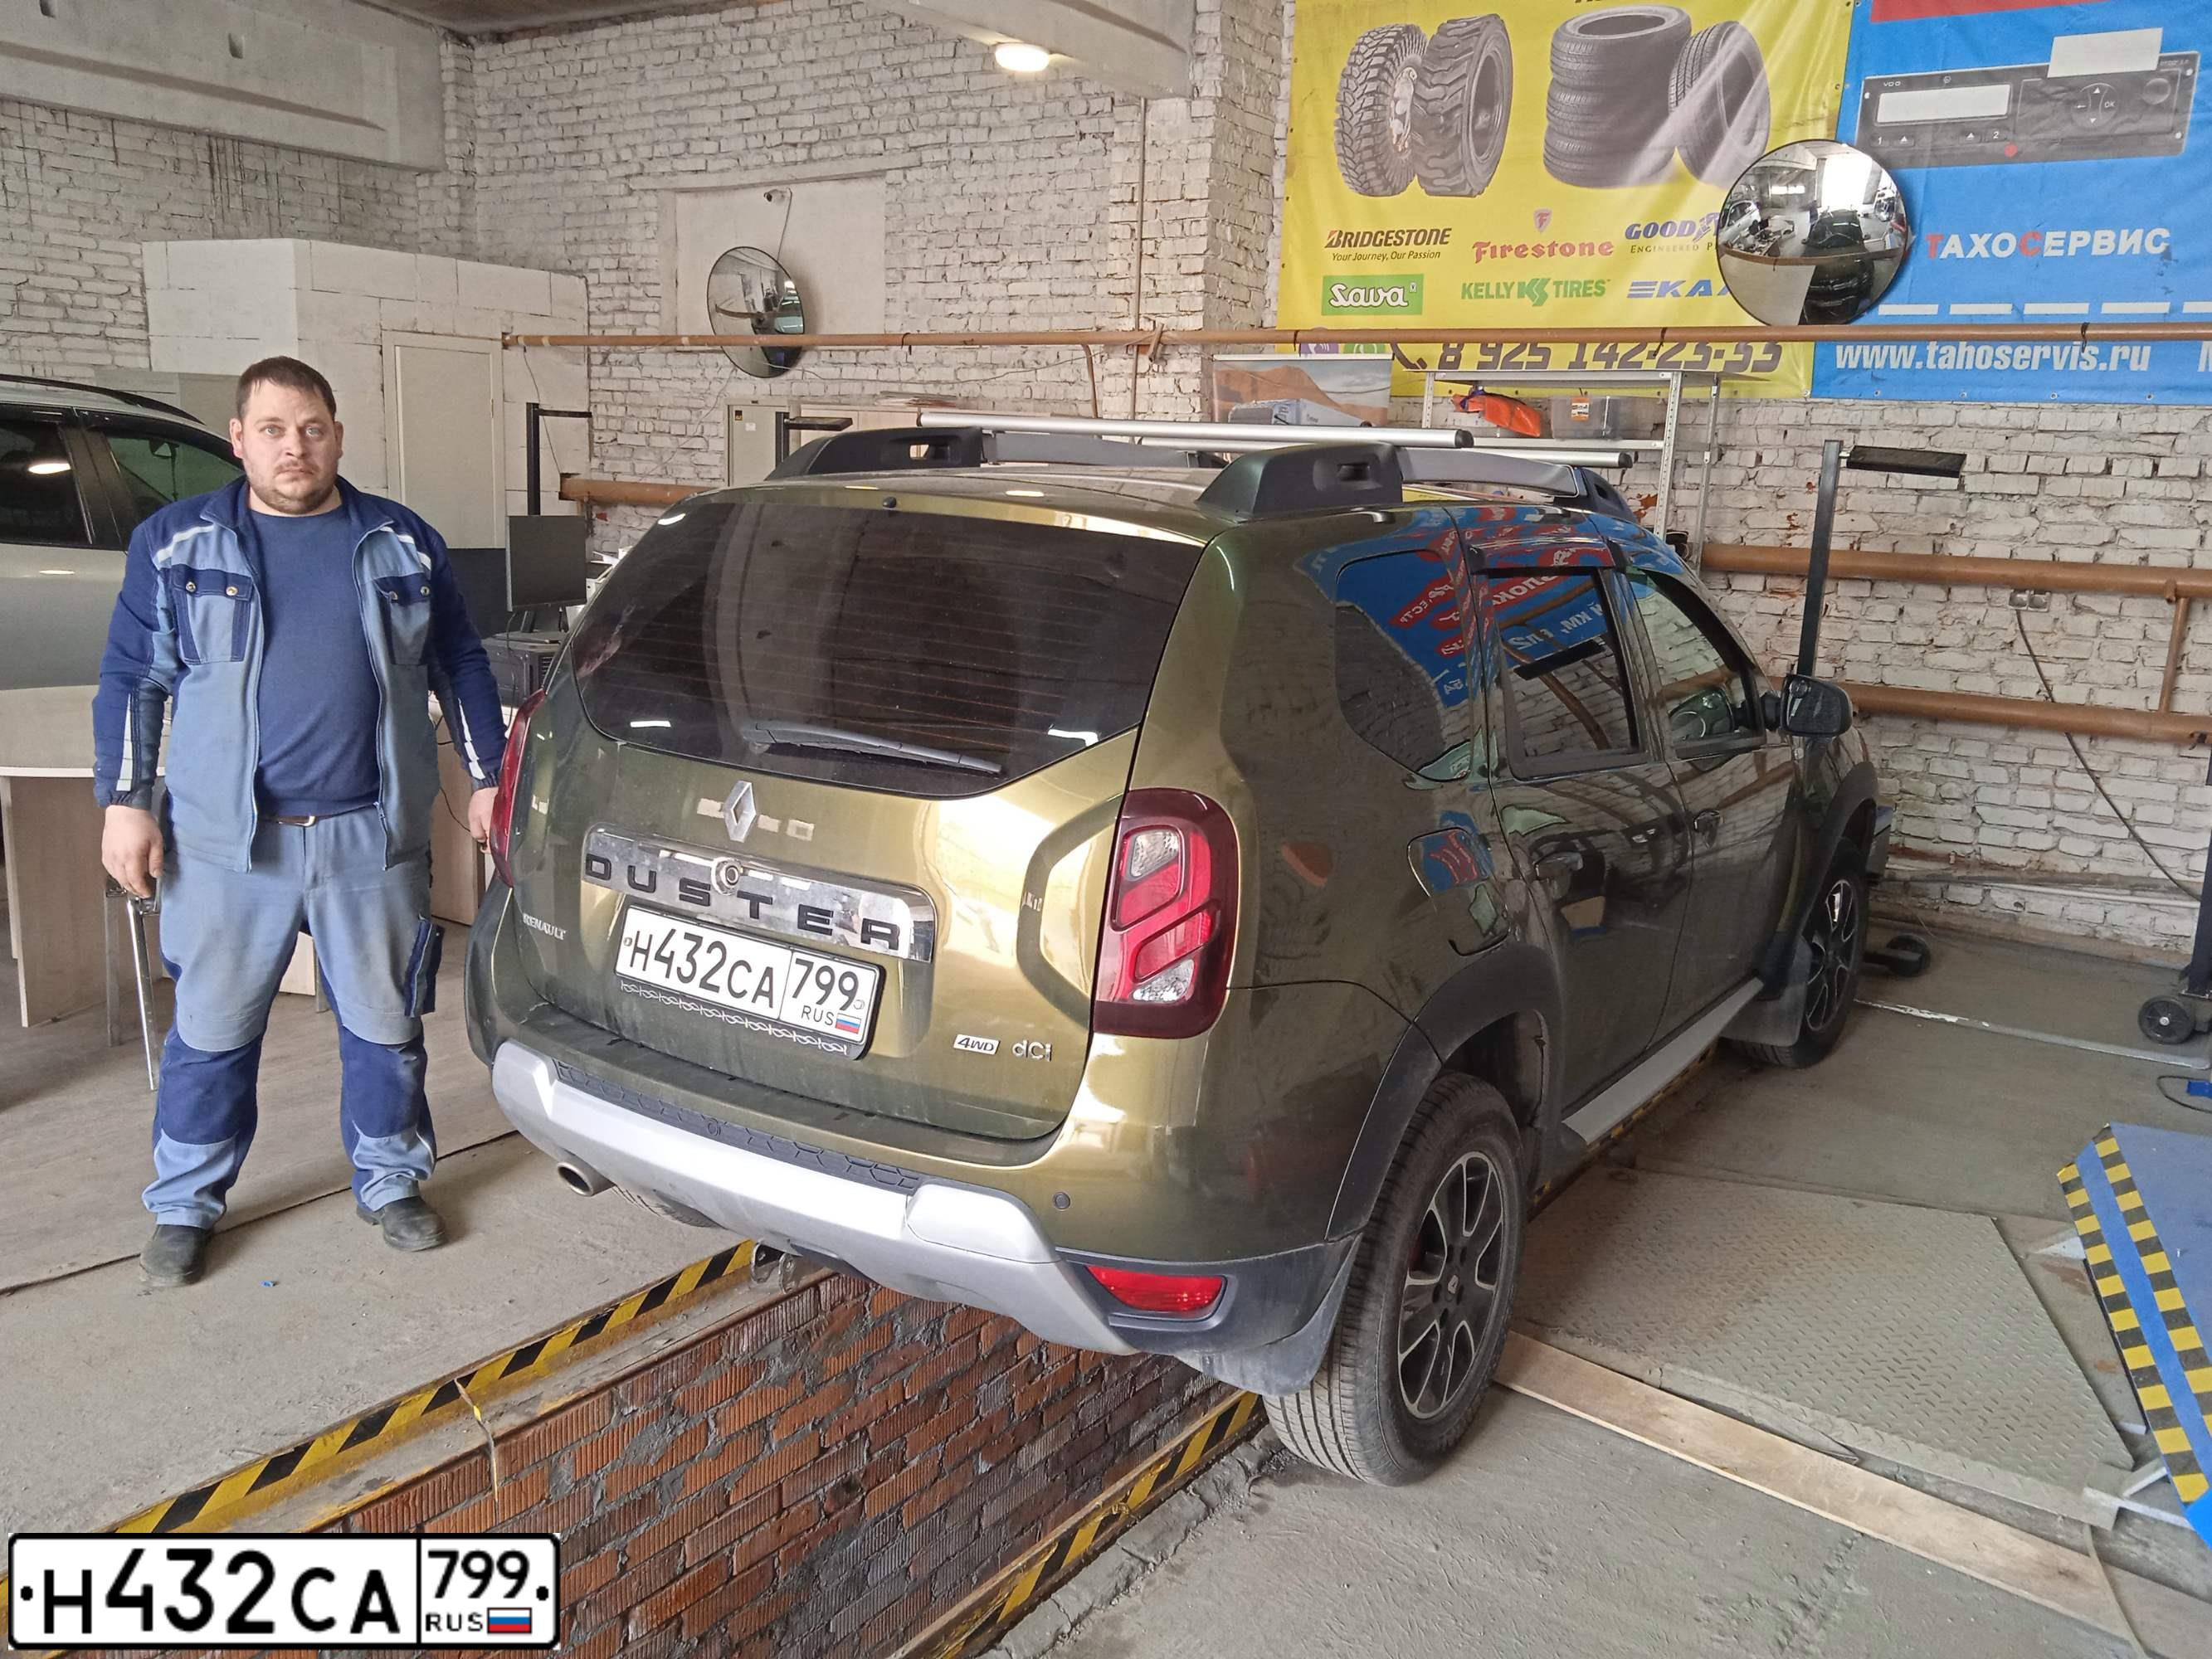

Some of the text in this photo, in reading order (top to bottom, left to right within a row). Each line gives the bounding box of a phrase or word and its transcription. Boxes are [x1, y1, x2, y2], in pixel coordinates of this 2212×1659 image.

[2103, 100, 2116, 109] OK
[1992, 130, 1999, 139] 2
[1324, 227, 1452, 249] BRIDGESTONE
[1925, 227, 2171, 259] ТАХОСЕРВИС
[1332, 250, 1441, 262] Your Journey, Our Passion
[1472, 240, 1614, 264] Firestone
[1328, 282, 1410, 309] Sava
[1460, 280, 1515, 299] KELLY
[1552, 279, 1607, 299] TIRES
[1438, 342, 1464, 371] 8
[1476, 342, 1552, 371] 925
[1834, 340, 2151, 372] www.tahoservis.ru
[585, 853, 900, 951] DUSTER
[523, 912, 567, 941] RENAULT
[791, 957, 860, 1012] 799
[801, 1005, 835, 1027] RUS
[957, 1036, 996, 1053] 4WD
